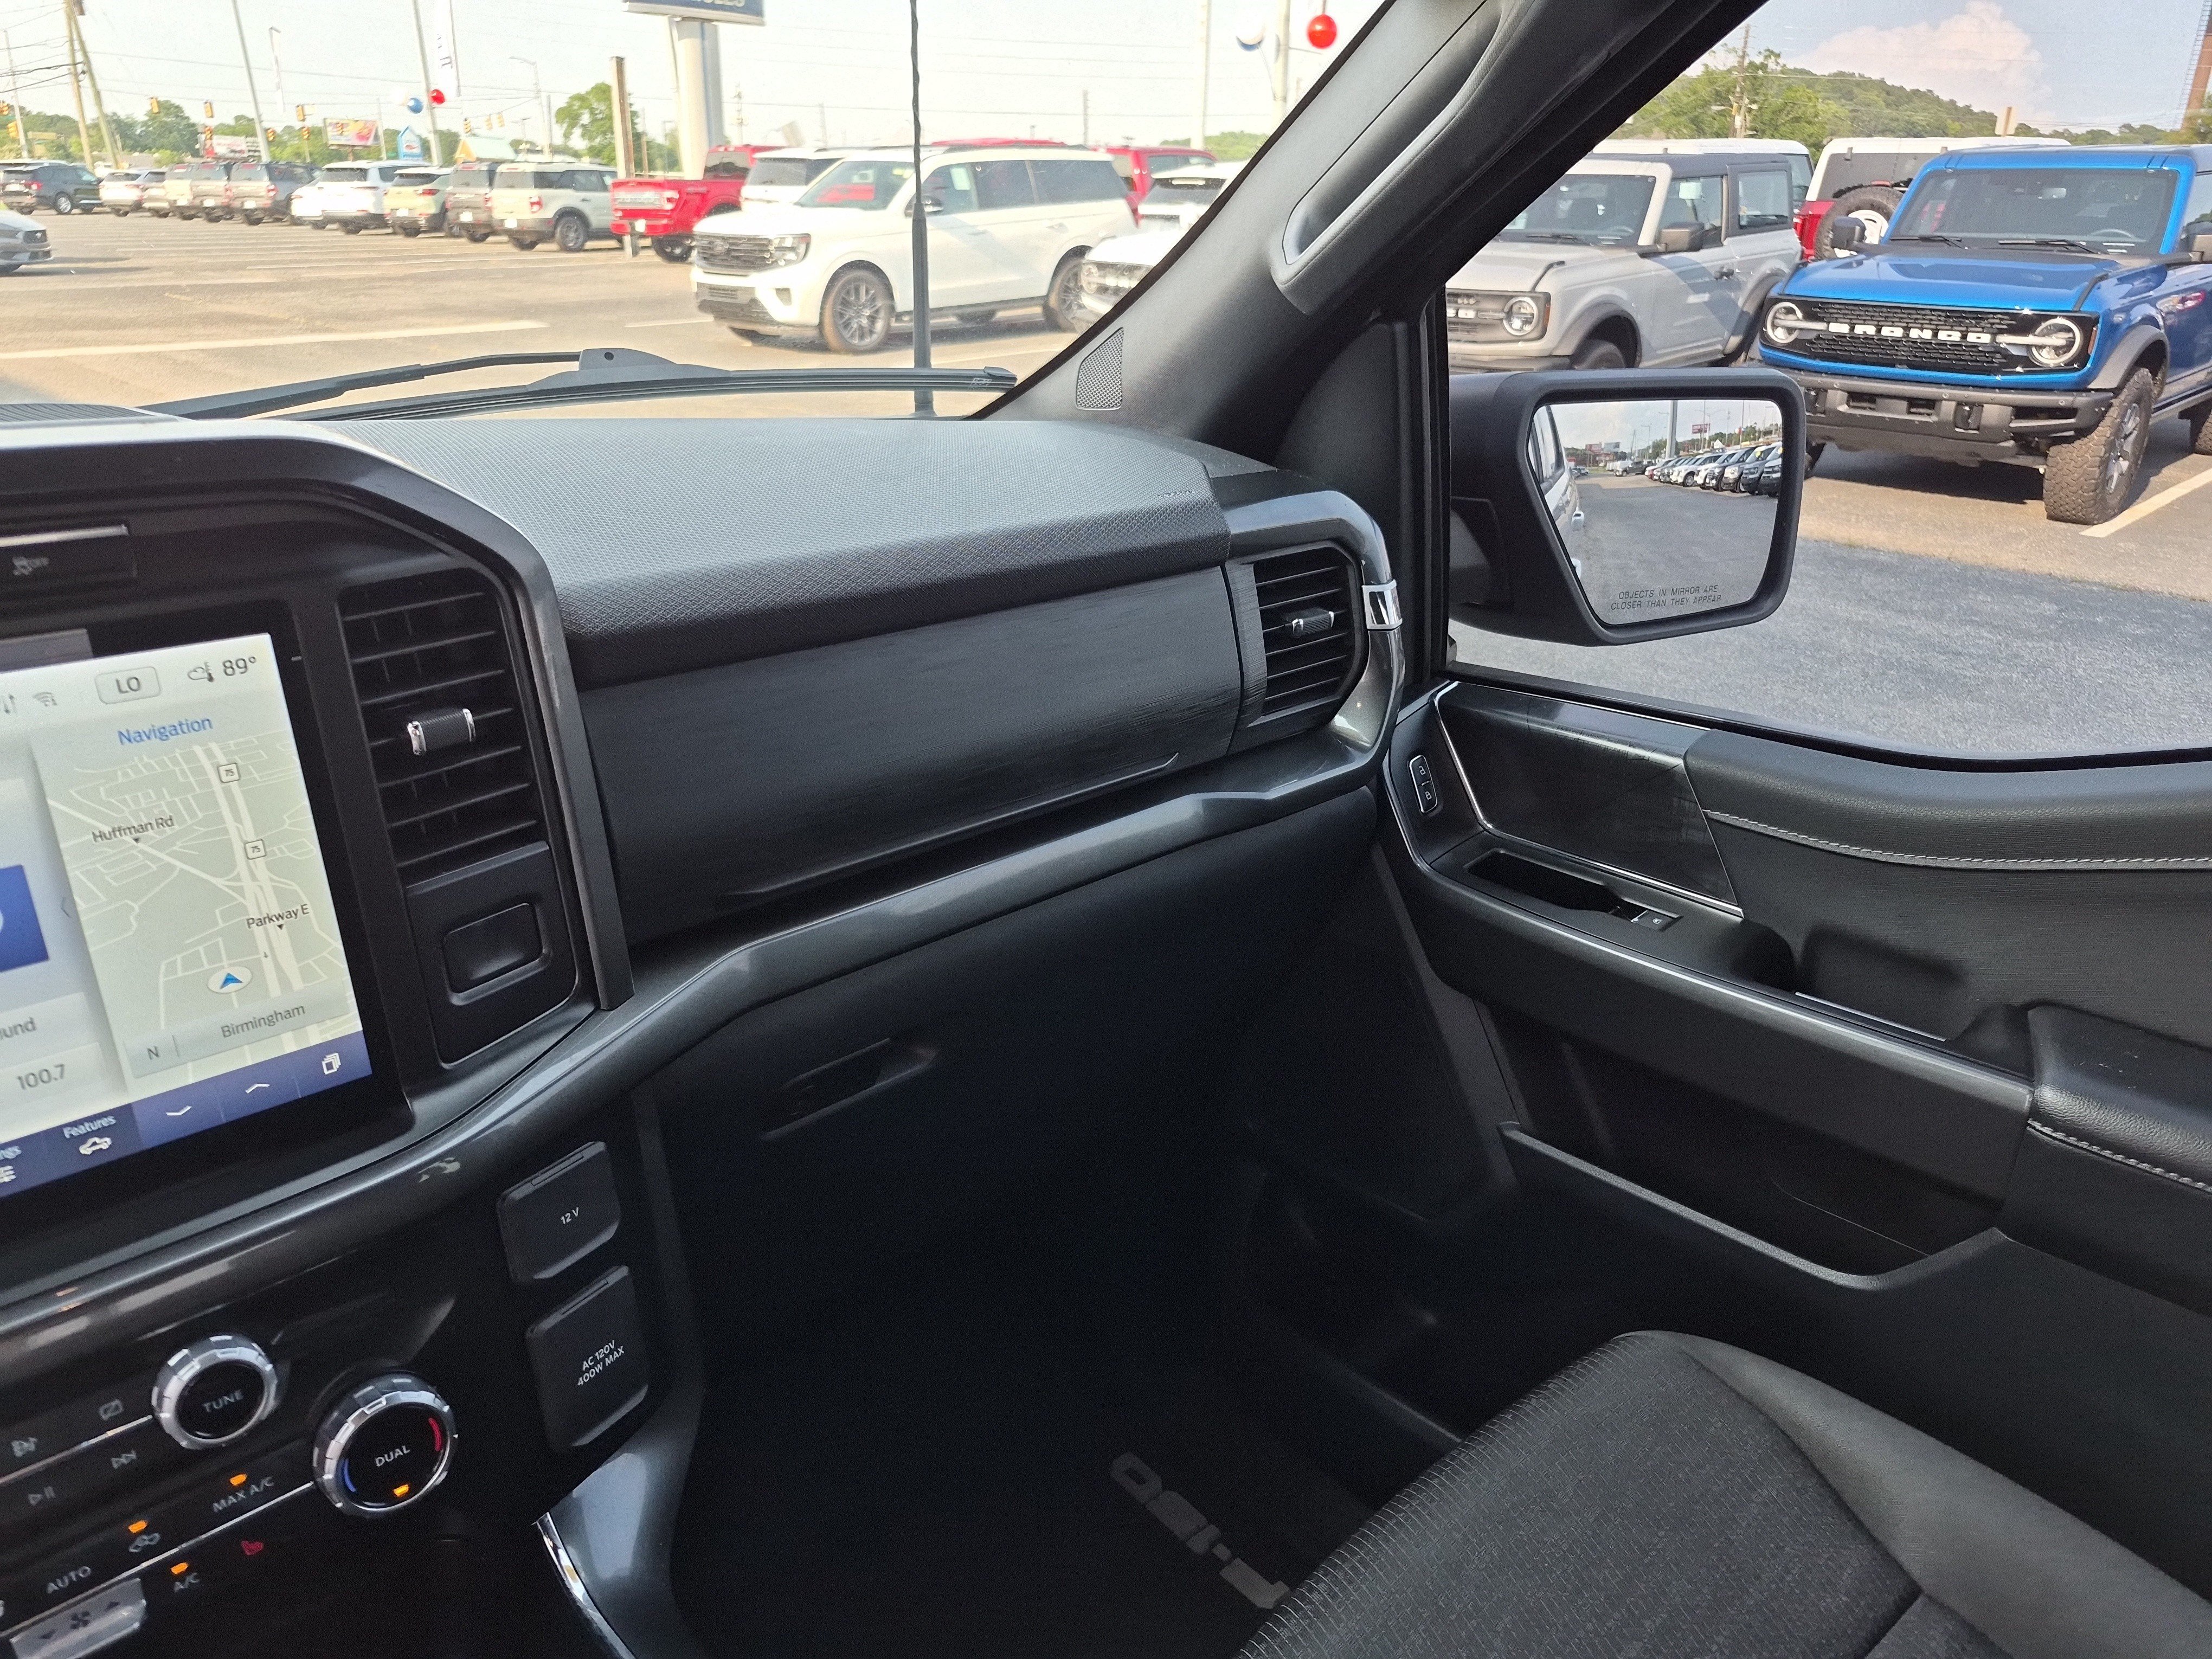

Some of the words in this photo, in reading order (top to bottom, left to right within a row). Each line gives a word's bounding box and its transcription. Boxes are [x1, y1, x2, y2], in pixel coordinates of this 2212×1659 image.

[1828, 322, 1991, 344] BRONCO
[1611, 601, 1642, 610] CLOSER
[1646, 599, 1667, 608] THAN
[1671, 597, 1690, 606] THEY
[1693, 594, 1722, 605] APPEAR
[1618, 589, 1654, 600] OBJECTS
[1670, 586, 1700, 596] MIRROR
[115, 677, 141, 694] LO
[117, 717, 214, 745] Navigation
[223, 768, 235, 777] 75
[91, 820, 155, 843] Huffman
[155, 815, 175, 829] Rd
[251, 845, 261, 854] 75
[246, 908, 299, 929] Parkway
[300, 904, 310, 915] E
[221, 1005, 305, 1038] Birmingham
[146, 1046, 159, 1060] N
[16, 1063, 65, 1090] 100.7
[63, 1115, 116, 1139] Features
[560, 1212, 572, 1225] 12
[571, 1206, 579, 1217] V
[577, 1361, 603, 1386] 400W
[605, 1345, 625, 1366] MAX
[582, 1356, 595, 1371] AC
[595, 1339, 615, 1360] 120V
[202, 1389, 243, 1413] TUNE
[374, 1445, 411, 1467] DUAL
[213, 1490, 247, 1513] MAX
[249, 1476, 274, 1495] A/C
[47, 1565, 92, 1594] AUTO
[173, 1572, 200, 1592] A/C
